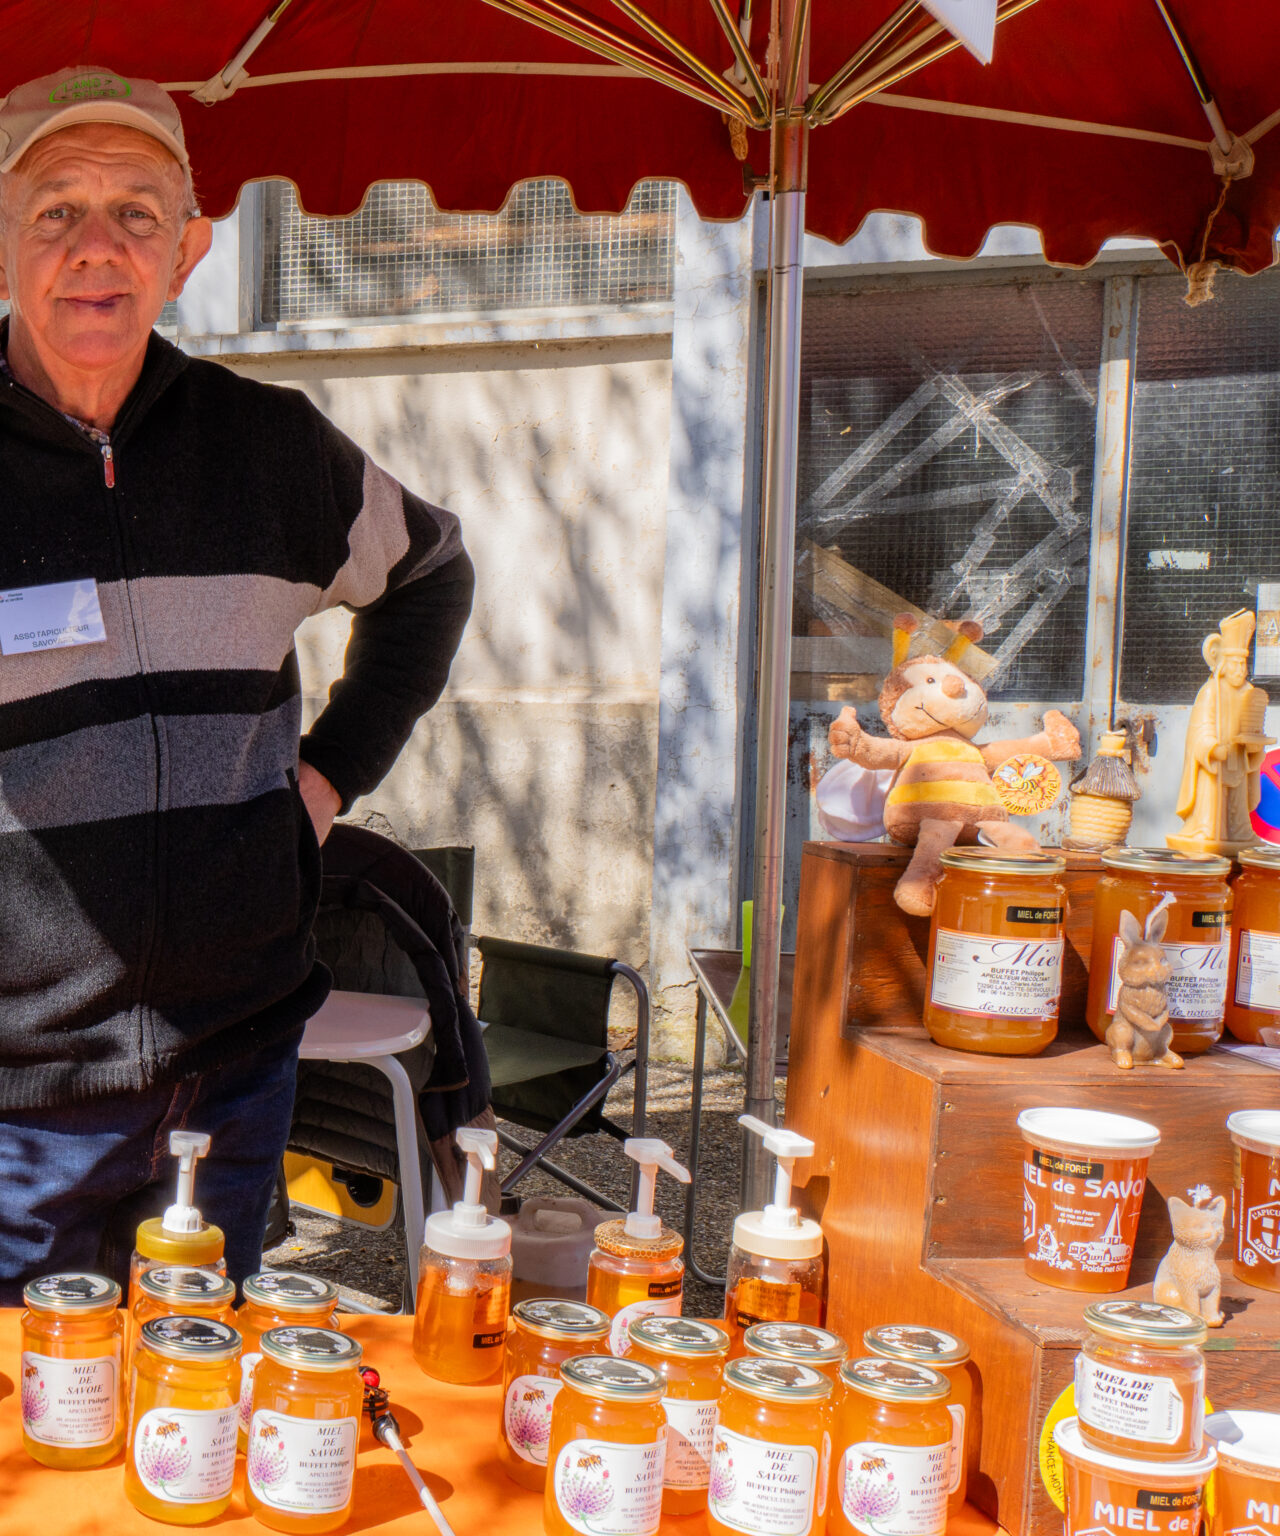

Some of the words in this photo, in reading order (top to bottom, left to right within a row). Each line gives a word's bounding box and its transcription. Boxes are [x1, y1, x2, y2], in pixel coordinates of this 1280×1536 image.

[14, 632, 36, 641] ASSO
[1017, 910, 1033, 919] MIEL
[1034, 911, 1042, 919] de
[1201, 915, 1215, 923] MIEL
[990, 967, 1020, 976] BUFFET
[981, 972, 1020, 982] APICULTEUR
[979, 1000, 994, 1012] de
[998, 1003, 1031, 1015] notre
[1039, 1154, 1054, 1169] MIEL
[1054, 1161, 1064, 1171] de
[1065, 1163, 1092, 1176] FORET
[1024, 1160, 1047, 1188] IEL
[1053, 1178, 1076, 1194] de
[1084, 1178, 1144, 1199] SAVO
[1081, 1263, 1103, 1273] Poids
[73, 1366, 98, 1375] MIEL
[79, 1375, 93, 1384] DE
[1092, 1369, 1128, 1387] MIEL
[1130, 1380, 1154, 1392] DE
[67, 1384, 103, 1395] SAVOIE
[1094, 1381, 1149, 1403] SAVOIE
[1120, 1401, 1148, 1412] Philippe
[701, 1418, 713, 1426] DE
[318, 1426, 343, 1436] MIEL
[688, 1427, 714, 1437] SAVO
[322, 1438, 337, 1446] DE
[309, 1446, 346, 1457] SAVOIE
[765, 1450, 794, 1461] MIEL
[927, 1451, 947, 1462] MIEL
[771, 1462, 788, 1471] DE
[932, 1462, 944, 1472] DE
[756, 1470, 800, 1483] SAVOIE
[780, 1487, 807, 1496] Philippe
[1150, 1495, 1170, 1506] MIEL
[1172, 1496, 1182, 1506] de
[1094, 1500, 1160, 1532] MIEL
[1169, 1516, 1189, 1532] de
[1246, 1499, 1280, 1526] MI
